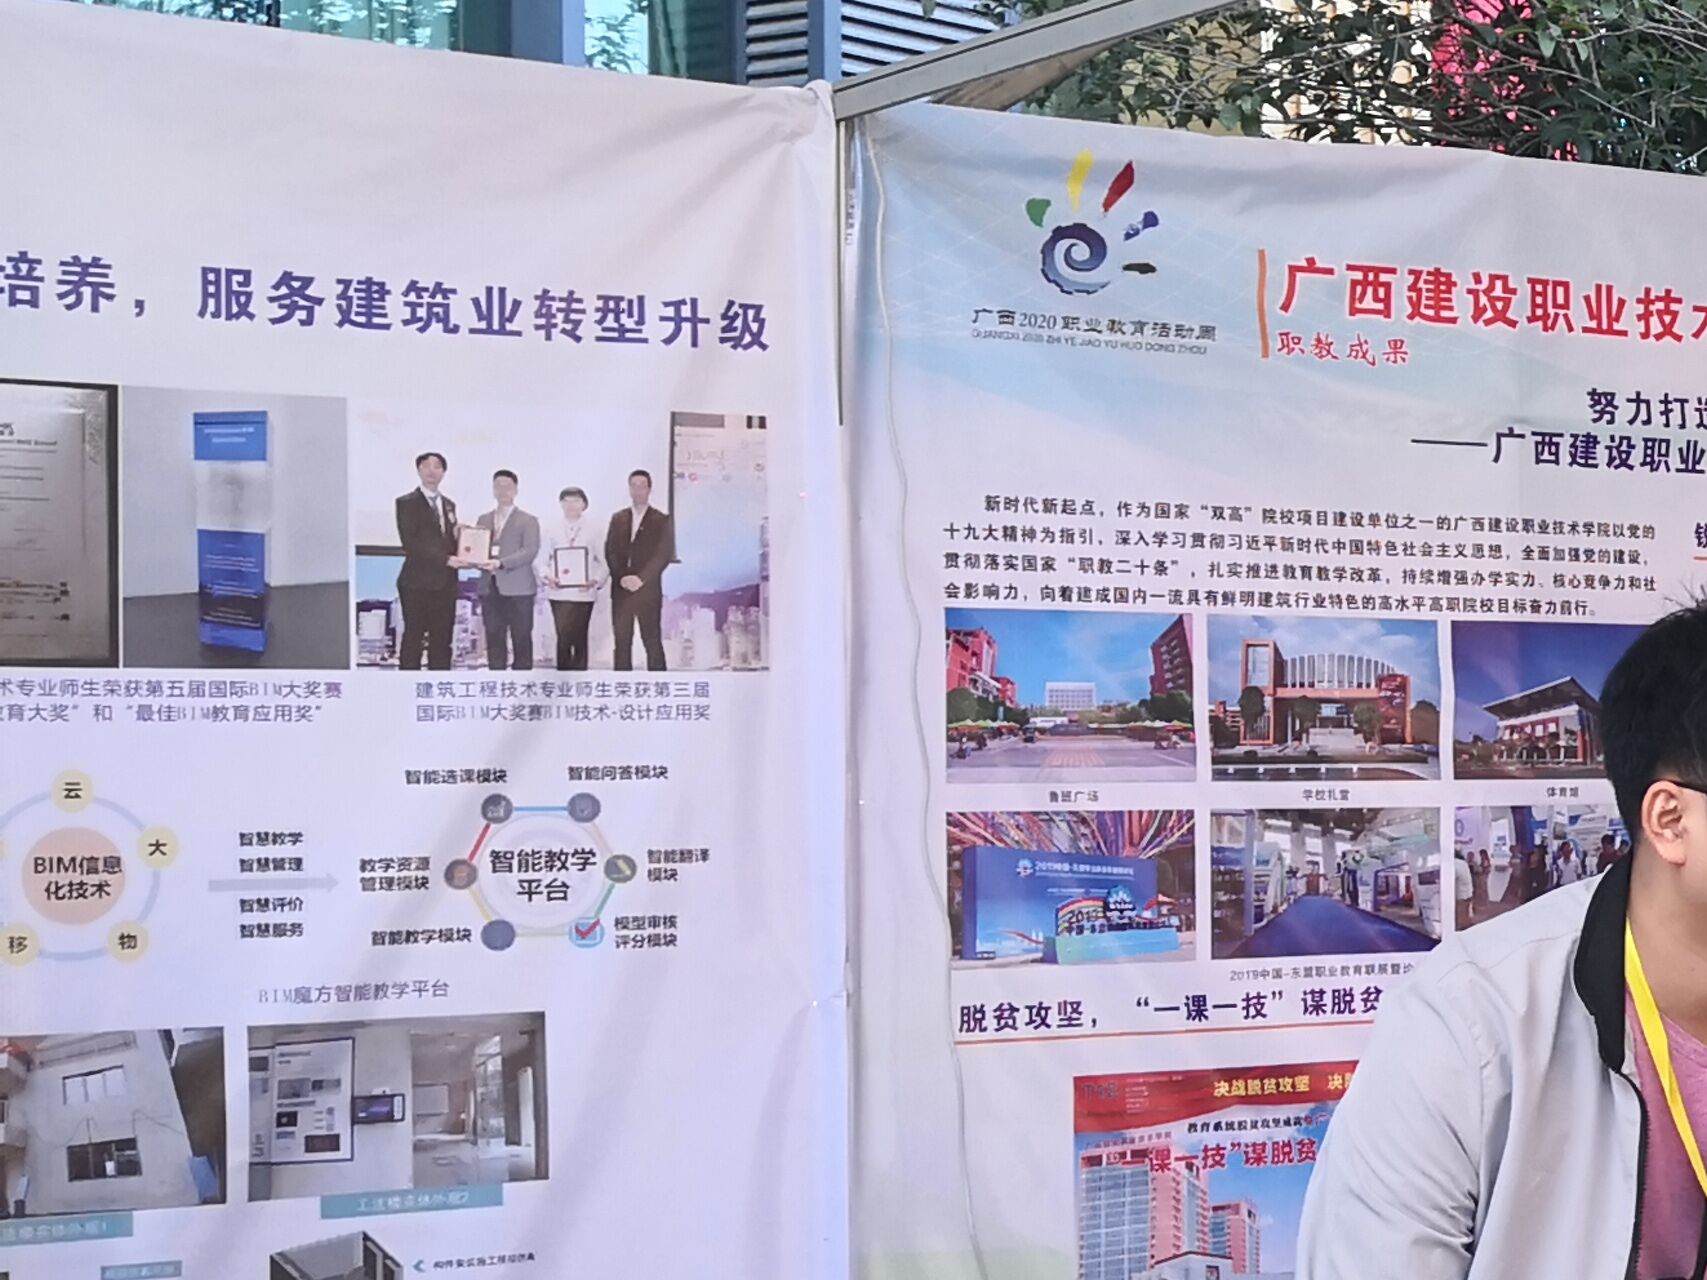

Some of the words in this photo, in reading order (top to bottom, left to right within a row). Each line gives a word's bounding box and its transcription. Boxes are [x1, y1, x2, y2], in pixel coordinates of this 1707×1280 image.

[0, 249, 773, 355] 培养，服务建筑业转型升级
[1276, 331, 1409, 368] 职教成果
[415, 680, 711, 700] 建筑工程技术专业师生荣获第三届
[404, 768, 509, 786] 智能选课模块
[567, 764, 669, 782] 智能问答模块
[63, 781, 83, 800] 云
[147, 838, 169, 857] 大
[239, 831, 304, 848] 智慧教学
[33, 855, 124, 876] BIM信息
[239, 857, 304, 874] 智慧管理
[488, 847, 598, 875] 智能教学
[44, 879, 113, 901] 化技术
[516, 878, 571, 903] 平台
[239, 896, 304, 915] 智慧评价
[239, 922, 304, 940] 智慧服务
[118, 932, 139, 952] 物
[957, 985, 1384, 1035] 脱贫攻坚，“一课一技”谋脱贫
[1212, 1074, 1312, 1098] 决战脱贫攻坚
